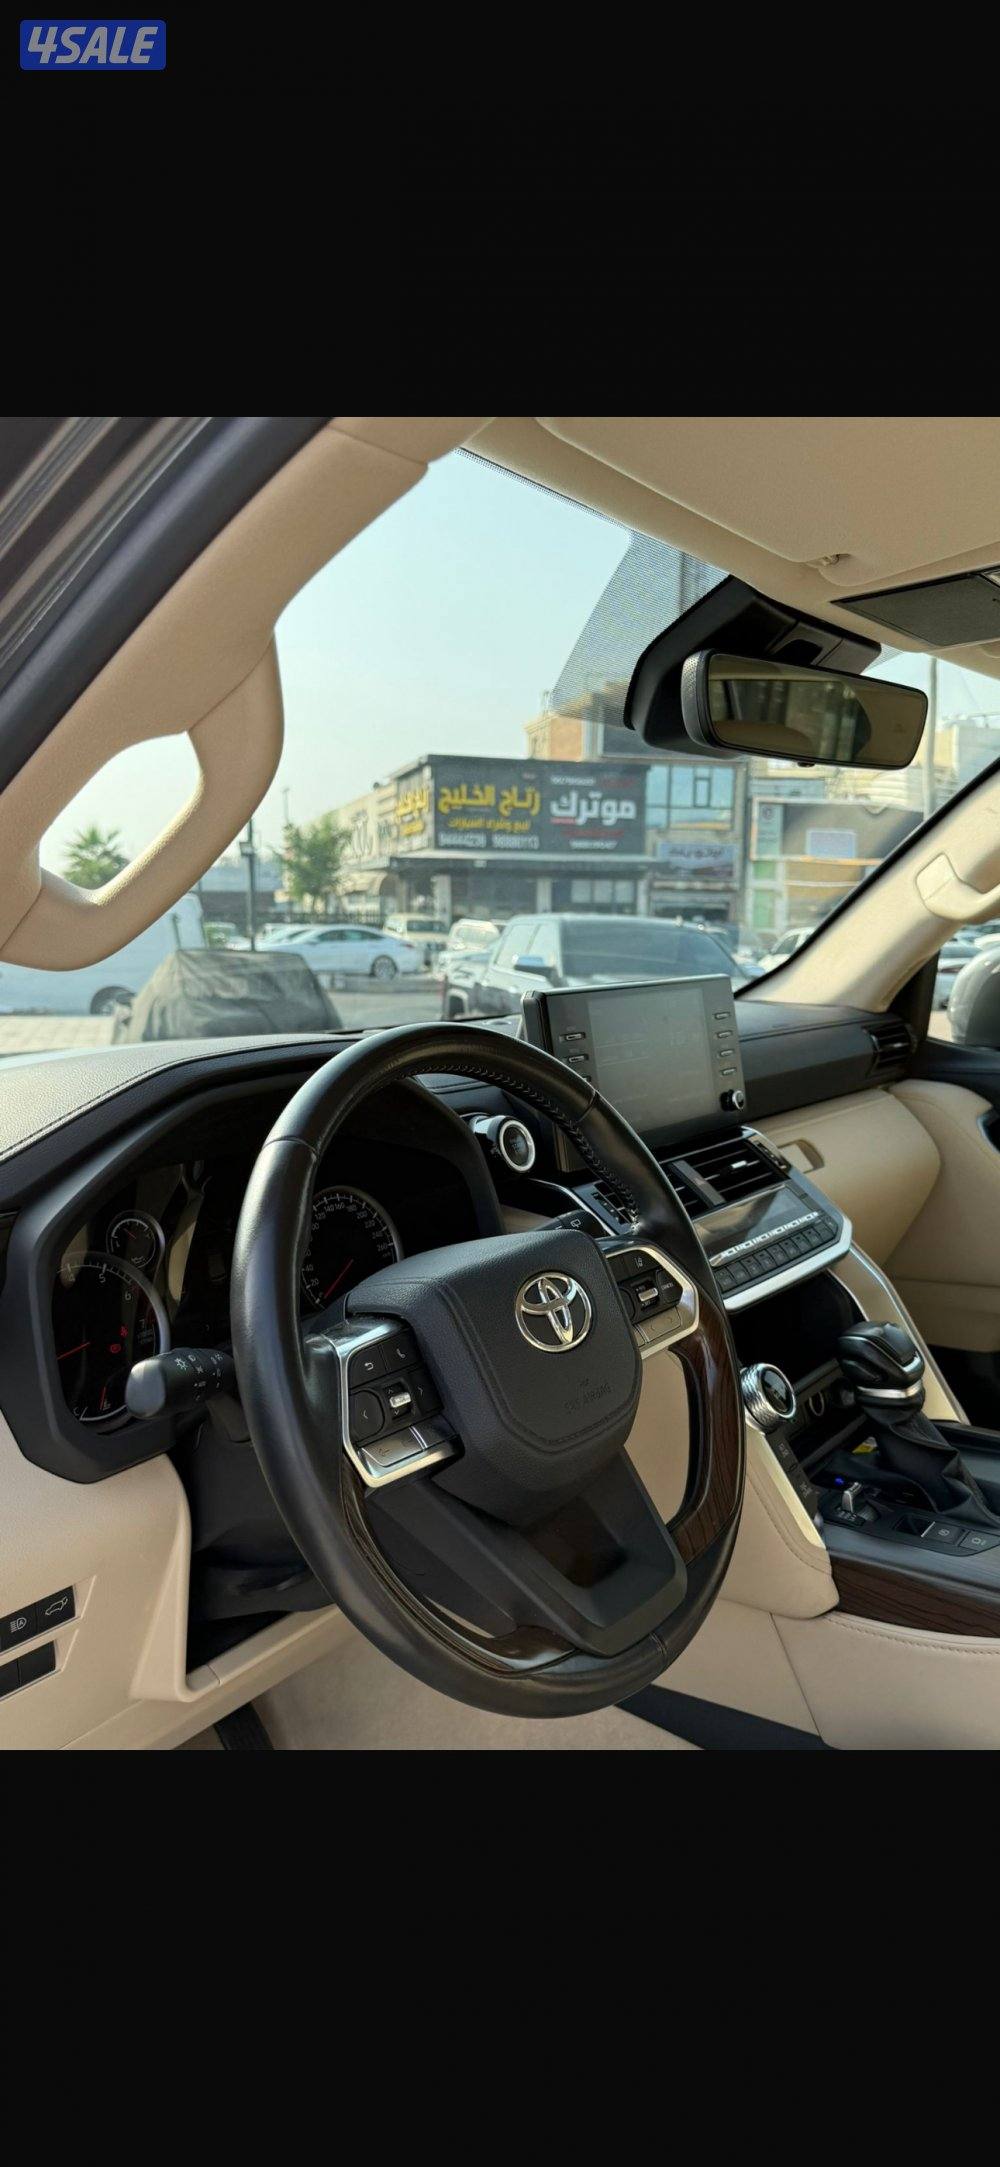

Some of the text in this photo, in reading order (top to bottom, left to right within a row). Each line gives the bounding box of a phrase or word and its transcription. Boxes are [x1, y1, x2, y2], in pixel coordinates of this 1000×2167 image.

[437, 783, 496, 815] الخليج
[550, 789, 637, 827] موترك
[98, 1273, 107, 1284] 5
[124, 1292, 132, 1302] 6
